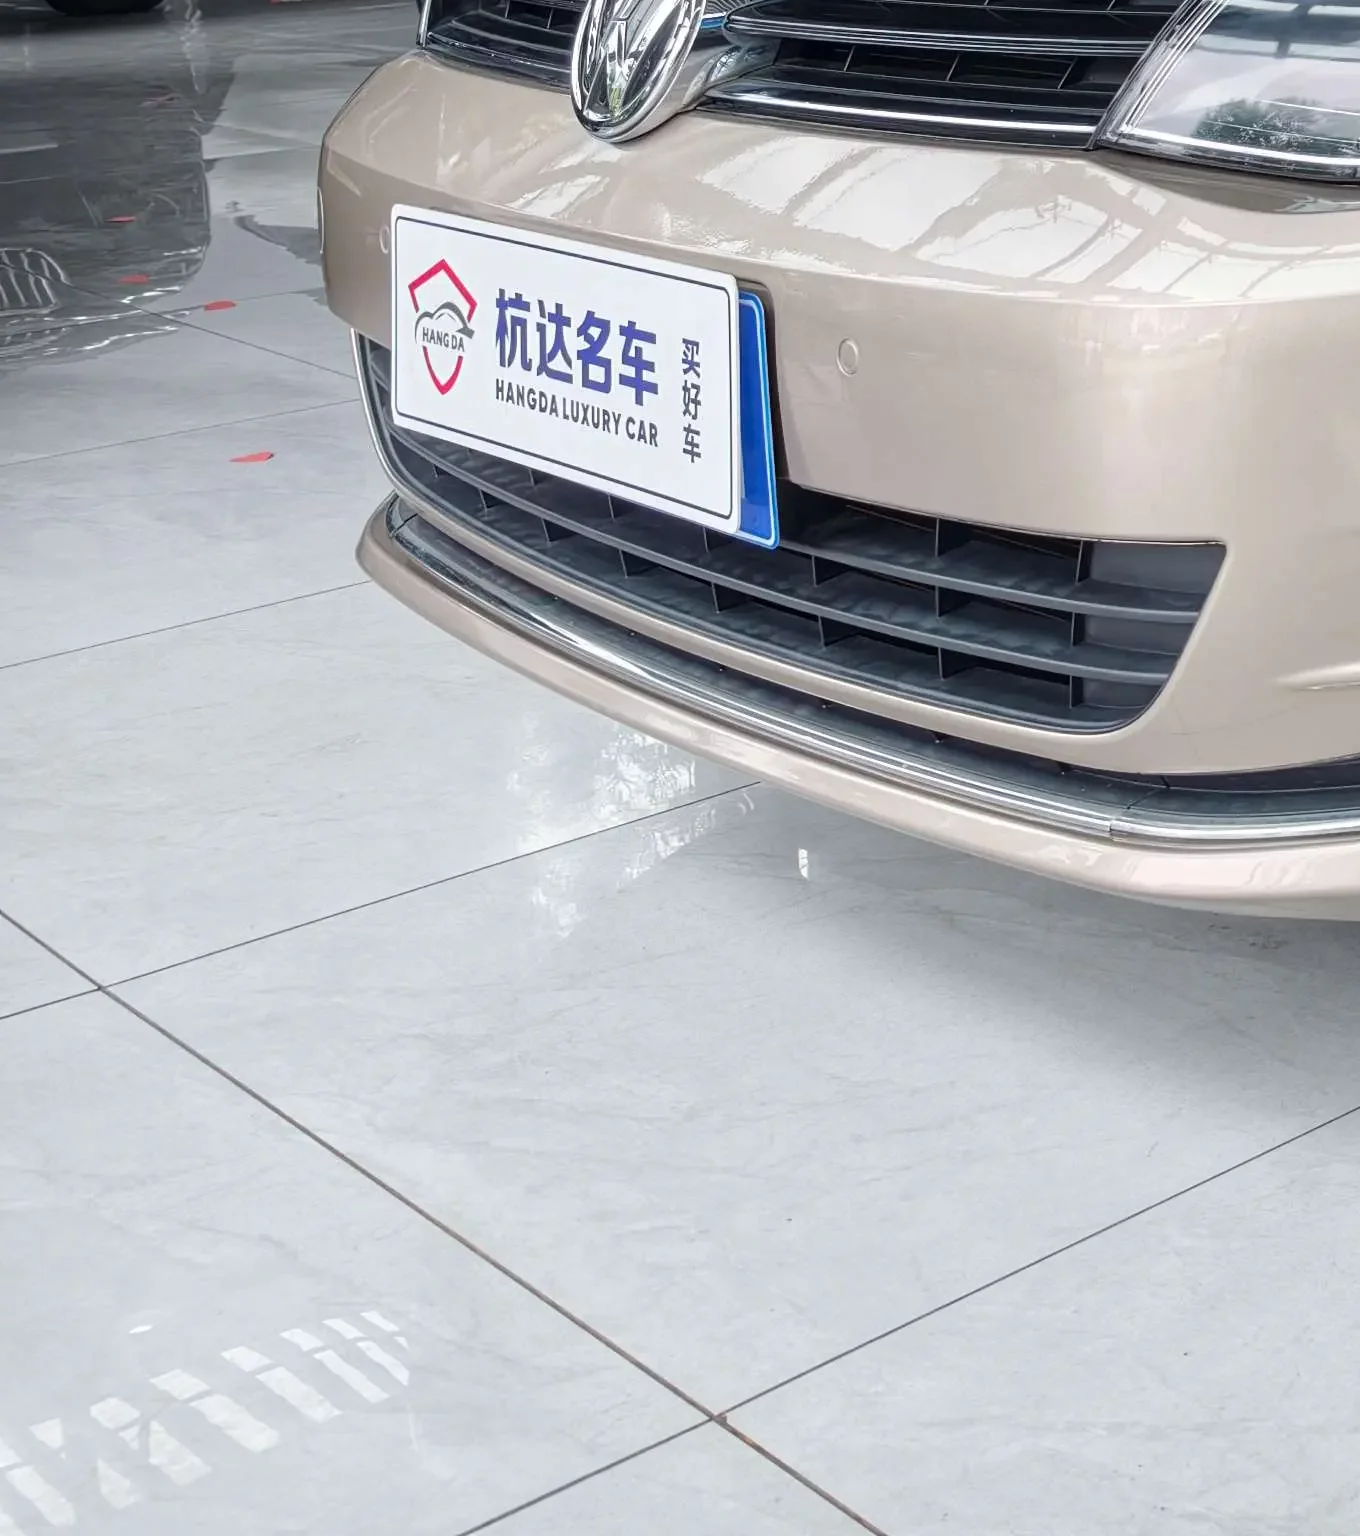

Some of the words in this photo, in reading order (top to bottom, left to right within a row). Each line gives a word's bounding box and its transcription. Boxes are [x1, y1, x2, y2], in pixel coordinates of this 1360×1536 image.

[422, 327, 449, 350] HANG
[450, 335, 466, 353] DA
[495, 288, 659, 406] 杭达名车
[495, 381, 559, 417] HANGDA
[562, 398, 621, 436] LUXURY
[625, 417, 659, 448] CAR
[681, 338, 702, 464] 买好车
